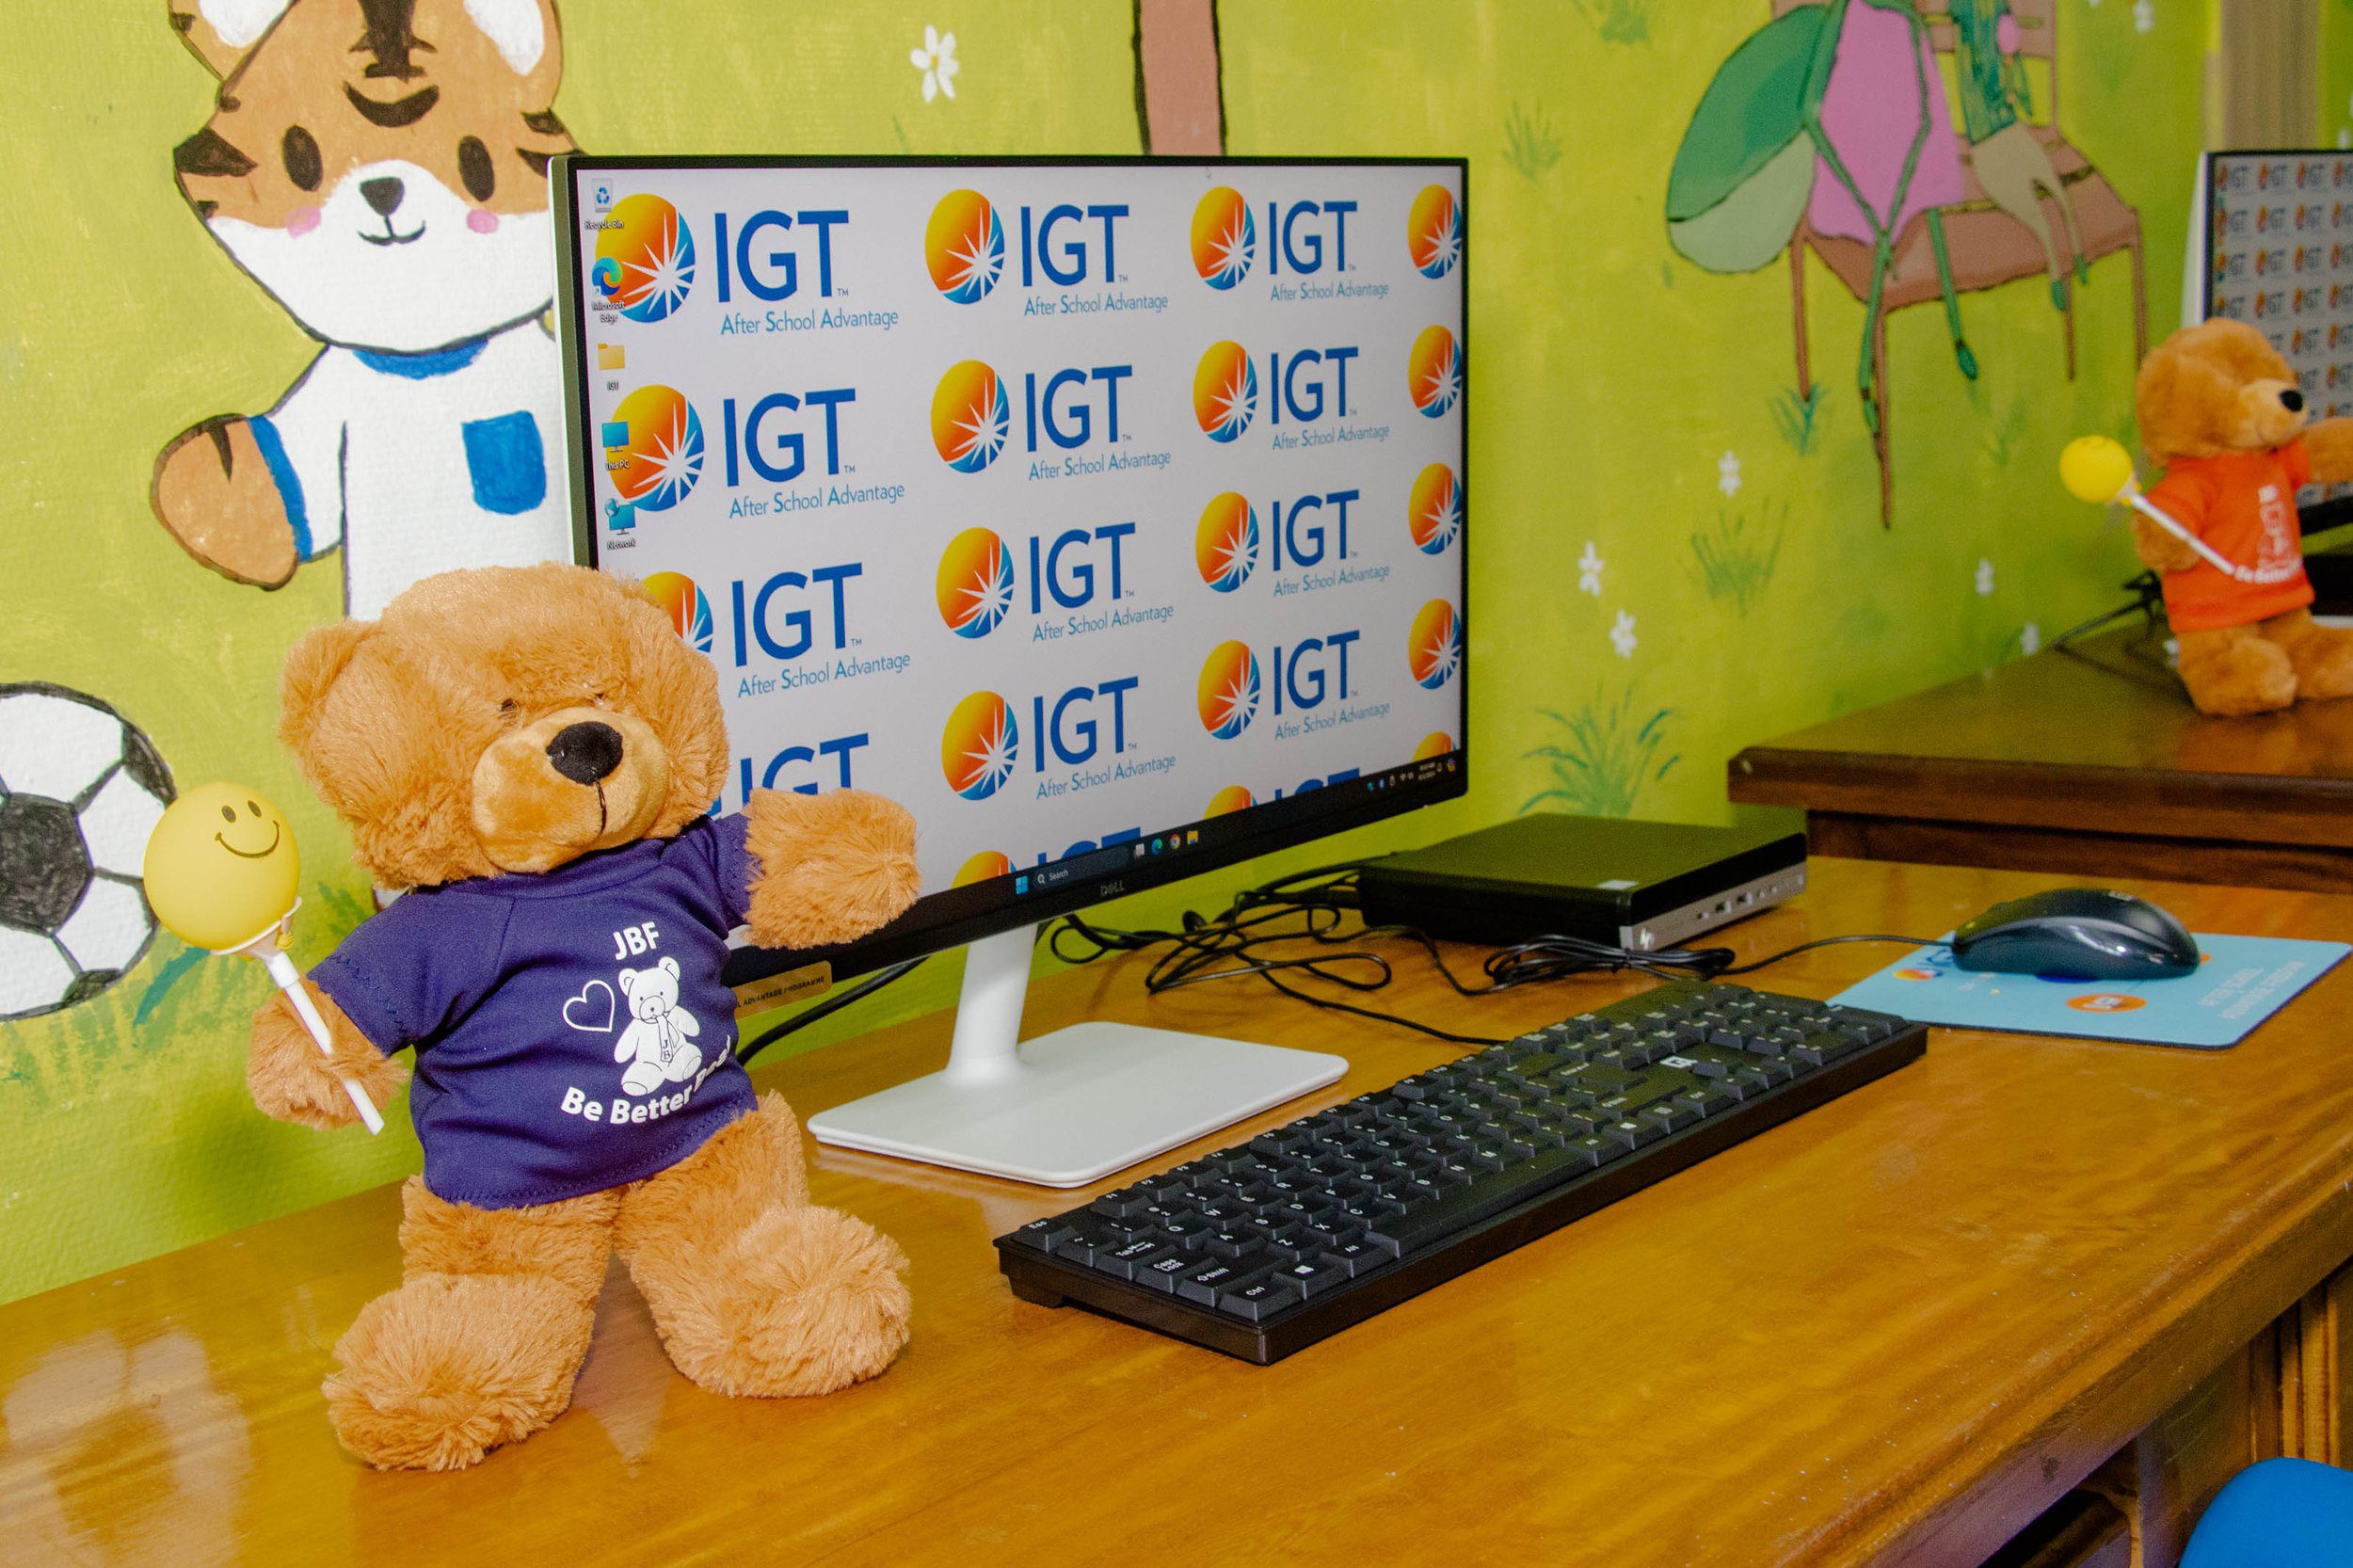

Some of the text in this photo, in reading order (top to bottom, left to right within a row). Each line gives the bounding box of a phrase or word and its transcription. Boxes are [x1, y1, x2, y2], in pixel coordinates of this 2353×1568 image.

[715, 211, 848, 302] IGT
[1021, 205, 1128, 286] IGT
[1270, 200, 1357, 274] IGT
[592, 300, 625, 311] Microsoft
[1024, 292, 1168, 316] After School Advantage
[1271, 280, 1389, 301] After School Advantage
[721, 308, 899, 335] After School Advantage
[1272, 346, 1358, 424] IGT
[1026, 365, 1132, 452] IGT
[724, 389, 856, 487] IGT
[1273, 424, 1390, 451] After School Advantage
[1029, 450, 1171, 481] After School Advantage
[729, 483, 905, 519] After School Advantage
[607, 538, 635, 550] Network
[1273, 489, 1359, 571] IGT
[1031, 522, 1135, 614] IGT
[1273, 565, 1390, 597] After School Advantage
[732, 563, 861, 666] IGT
[1032, 603, 1175, 643] After School Advantage
[738, 651, 911, 698] After School Advantage
[1274, 631, 1359, 715] IGT
[1034, 677, 1138, 772] IGT
[1275, 699, 1391, 741] After School Advantage
[1036, 753, 1176, 800] After School Advantage
[1049, 869, 1068, 881] Search
[614, 921, 659, 960] JBF
[561, 1086, 602, 1122] Be
[610, 1084, 692, 1124] Better
